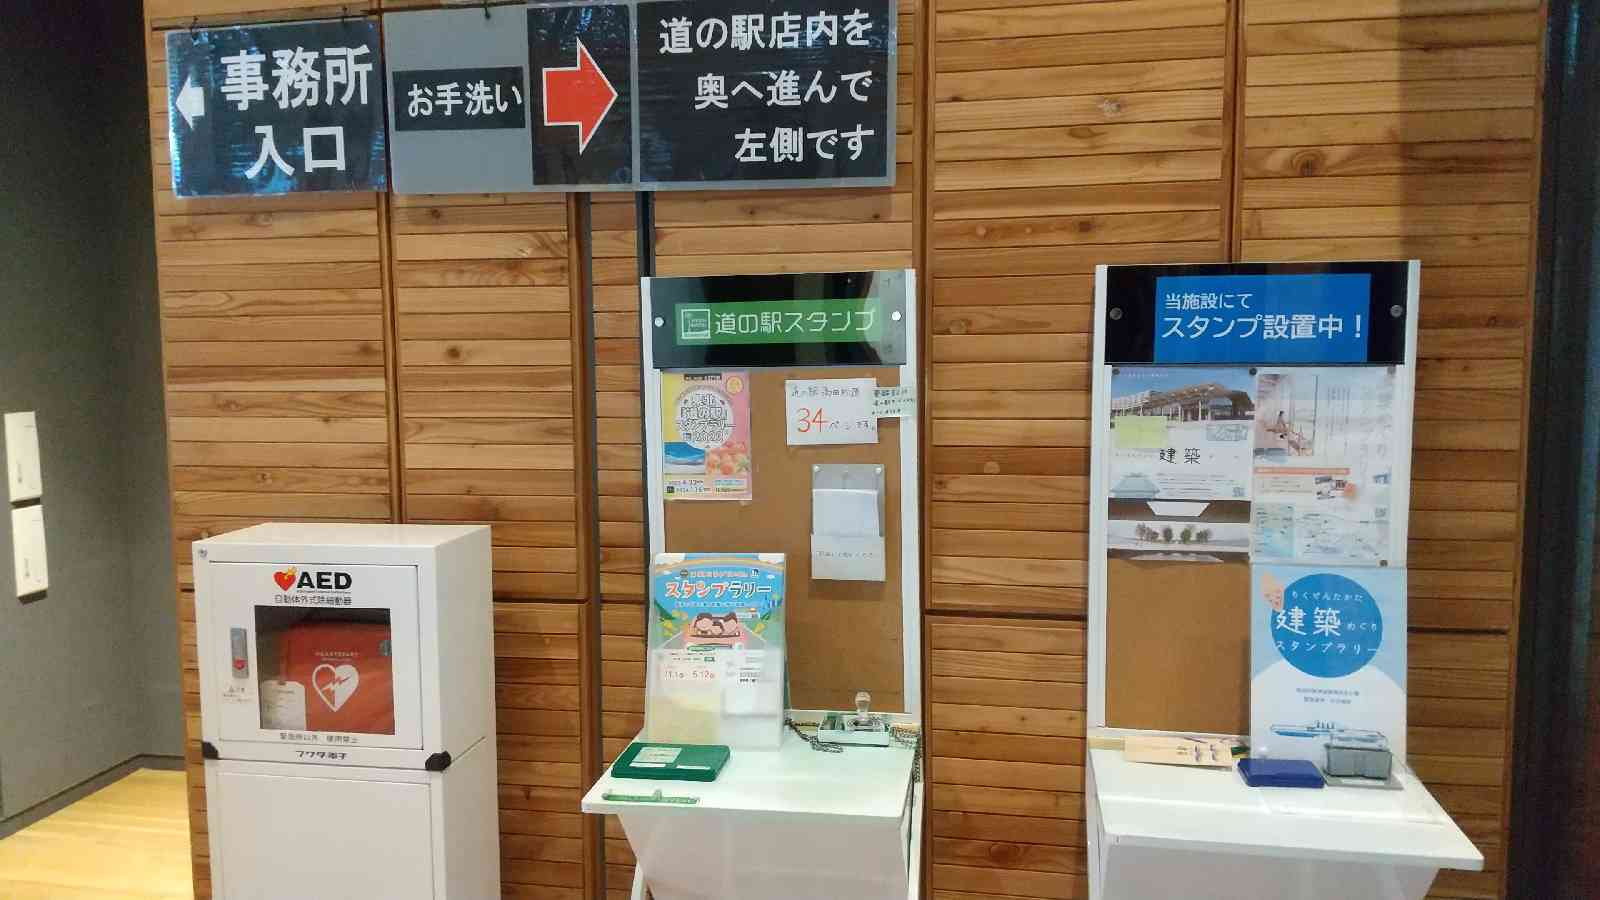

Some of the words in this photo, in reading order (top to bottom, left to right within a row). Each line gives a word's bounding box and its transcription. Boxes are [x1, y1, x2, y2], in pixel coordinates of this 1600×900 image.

[658, 9, 873, 55] 道の駅店内を
[220, 44, 373, 111] 事務所
[694, 70, 872, 110] 奥へ進んで
[407, 80, 523, 117] お手洗い
[245, 125, 346, 179] 入口
[734, 123, 875, 163] 左側です
[1164, 292, 1253, 310] 当施設にて
[715, 312, 876, 333] 道の駅スタンプ
[1159, 447, 1201, 465] 建築
[296, 571, 352, 590] AED
[664, 579, 773, 600] スタンプラリー
[1275, 640, 1377, 655] スタンプラリー
